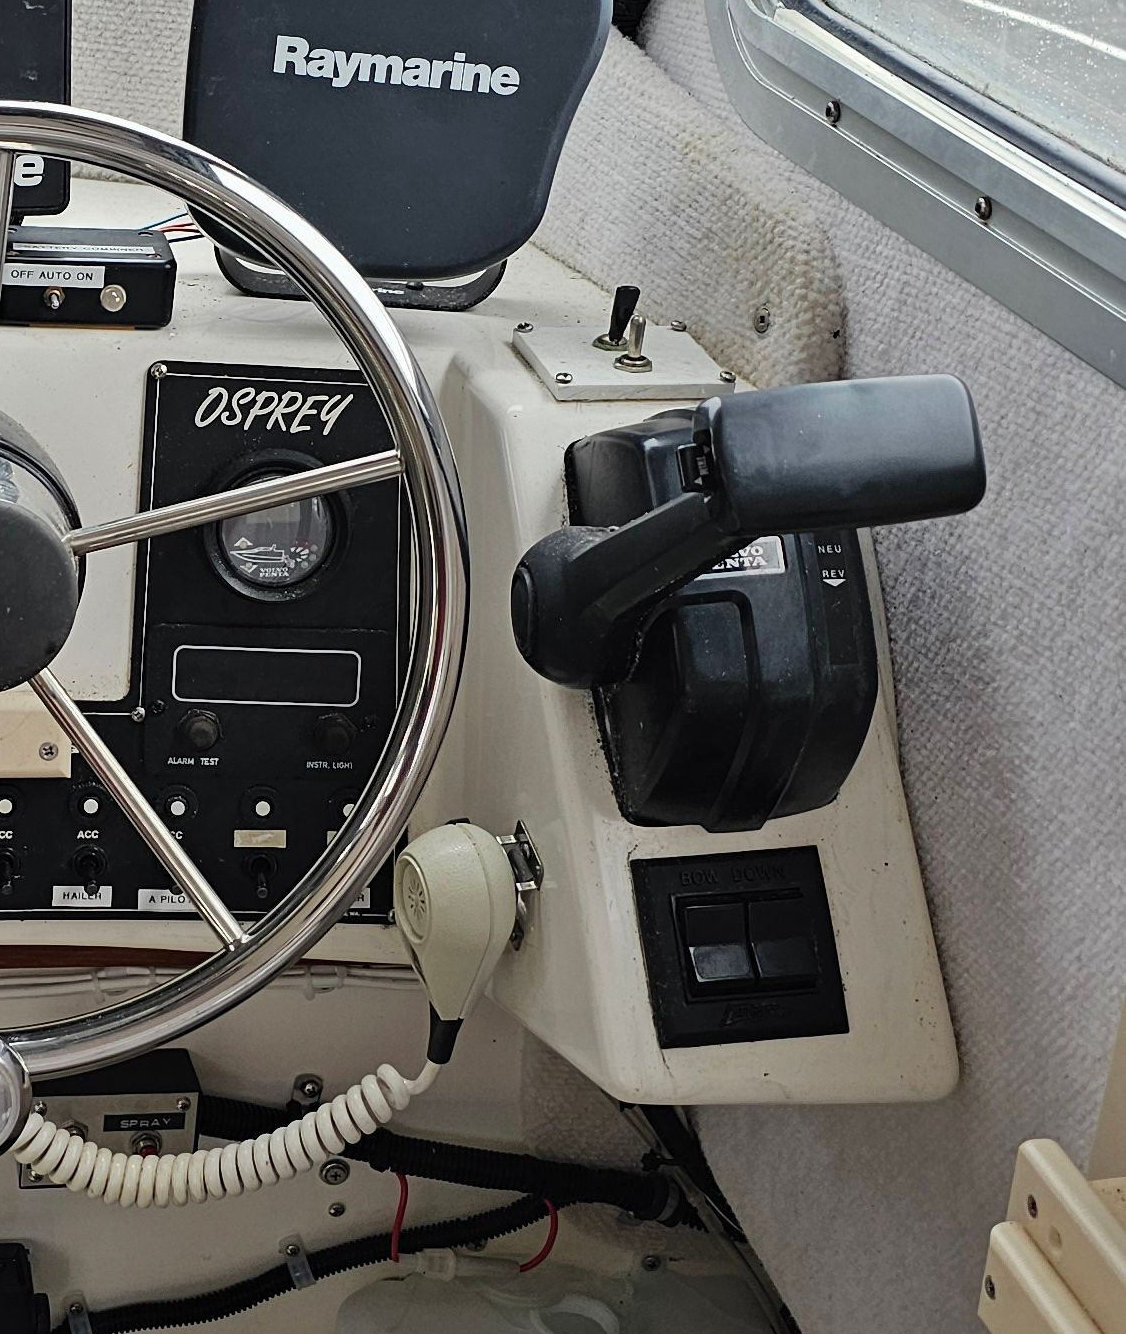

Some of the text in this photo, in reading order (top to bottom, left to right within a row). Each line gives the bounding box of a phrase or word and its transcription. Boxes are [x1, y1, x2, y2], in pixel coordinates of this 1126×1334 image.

[273, 35, 520, 96] Raymarine
[10, 269, 93, 281] OFF AUTO ON
[194, 386, 354, 436] OSPREY
[817, 545, 842, 554] NEU
[712, 556, 768, 570] ENTA
[821, 570, 845, 578] REV
[167, 757, 219, 766] ALARM TEST
[77, 830, 99, 840] ACC
[680, 865, 787, 886] BOW DOWN
[148, 895, 186, 904] A PILO
[120, 1118, 171, 1129] SPRAY
